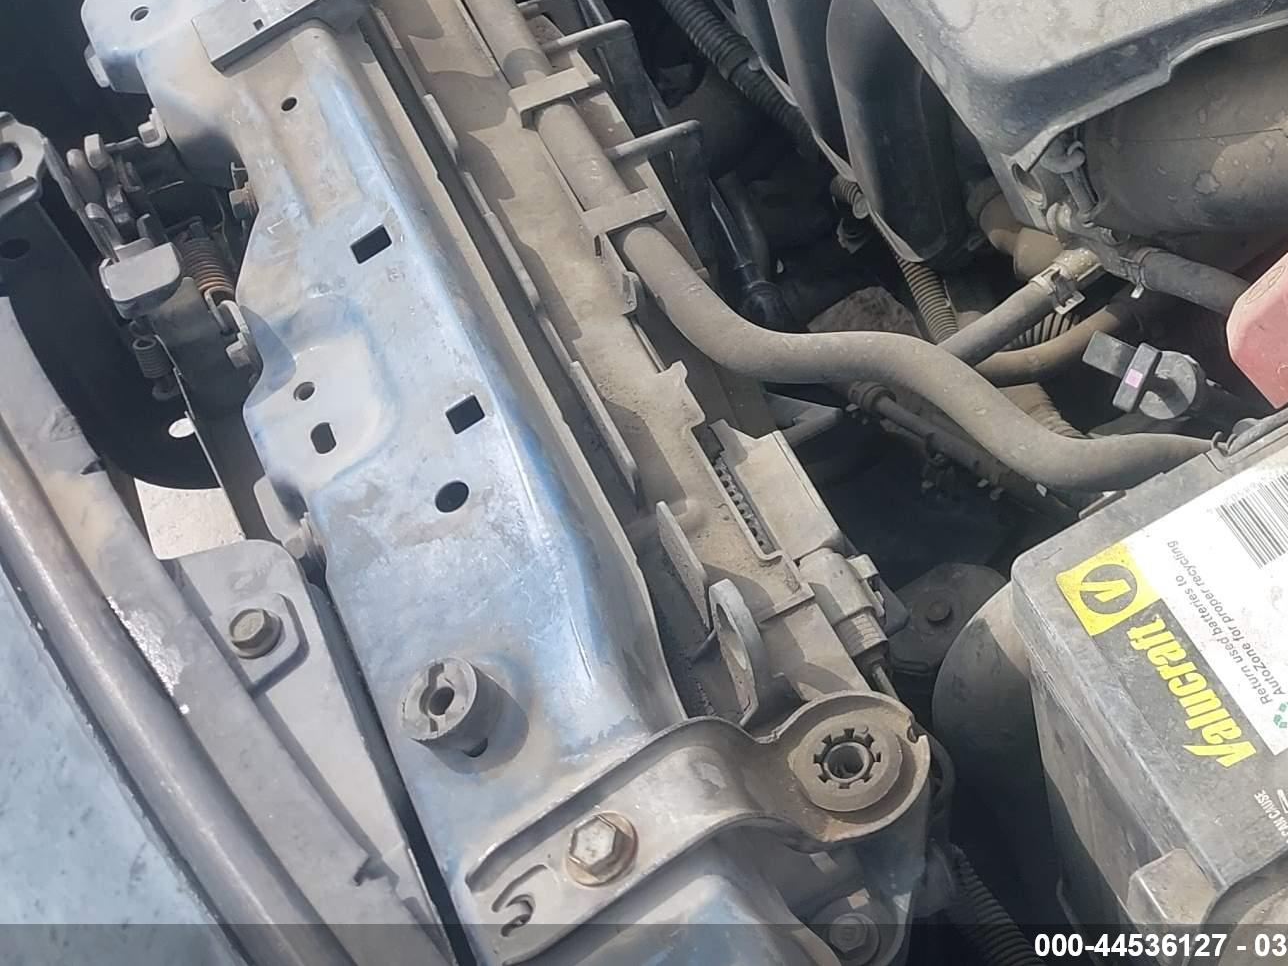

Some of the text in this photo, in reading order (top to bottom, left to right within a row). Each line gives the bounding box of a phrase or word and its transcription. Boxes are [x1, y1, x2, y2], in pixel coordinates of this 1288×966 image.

[1164, 537, 1286, 698] AutoZone for proper recycling
[1173, 573, 1273, 705] Return used batteries to
[1122, 613, 1256, 769] Valucraft
[1253, 787, 1282, 820] CAUSE
